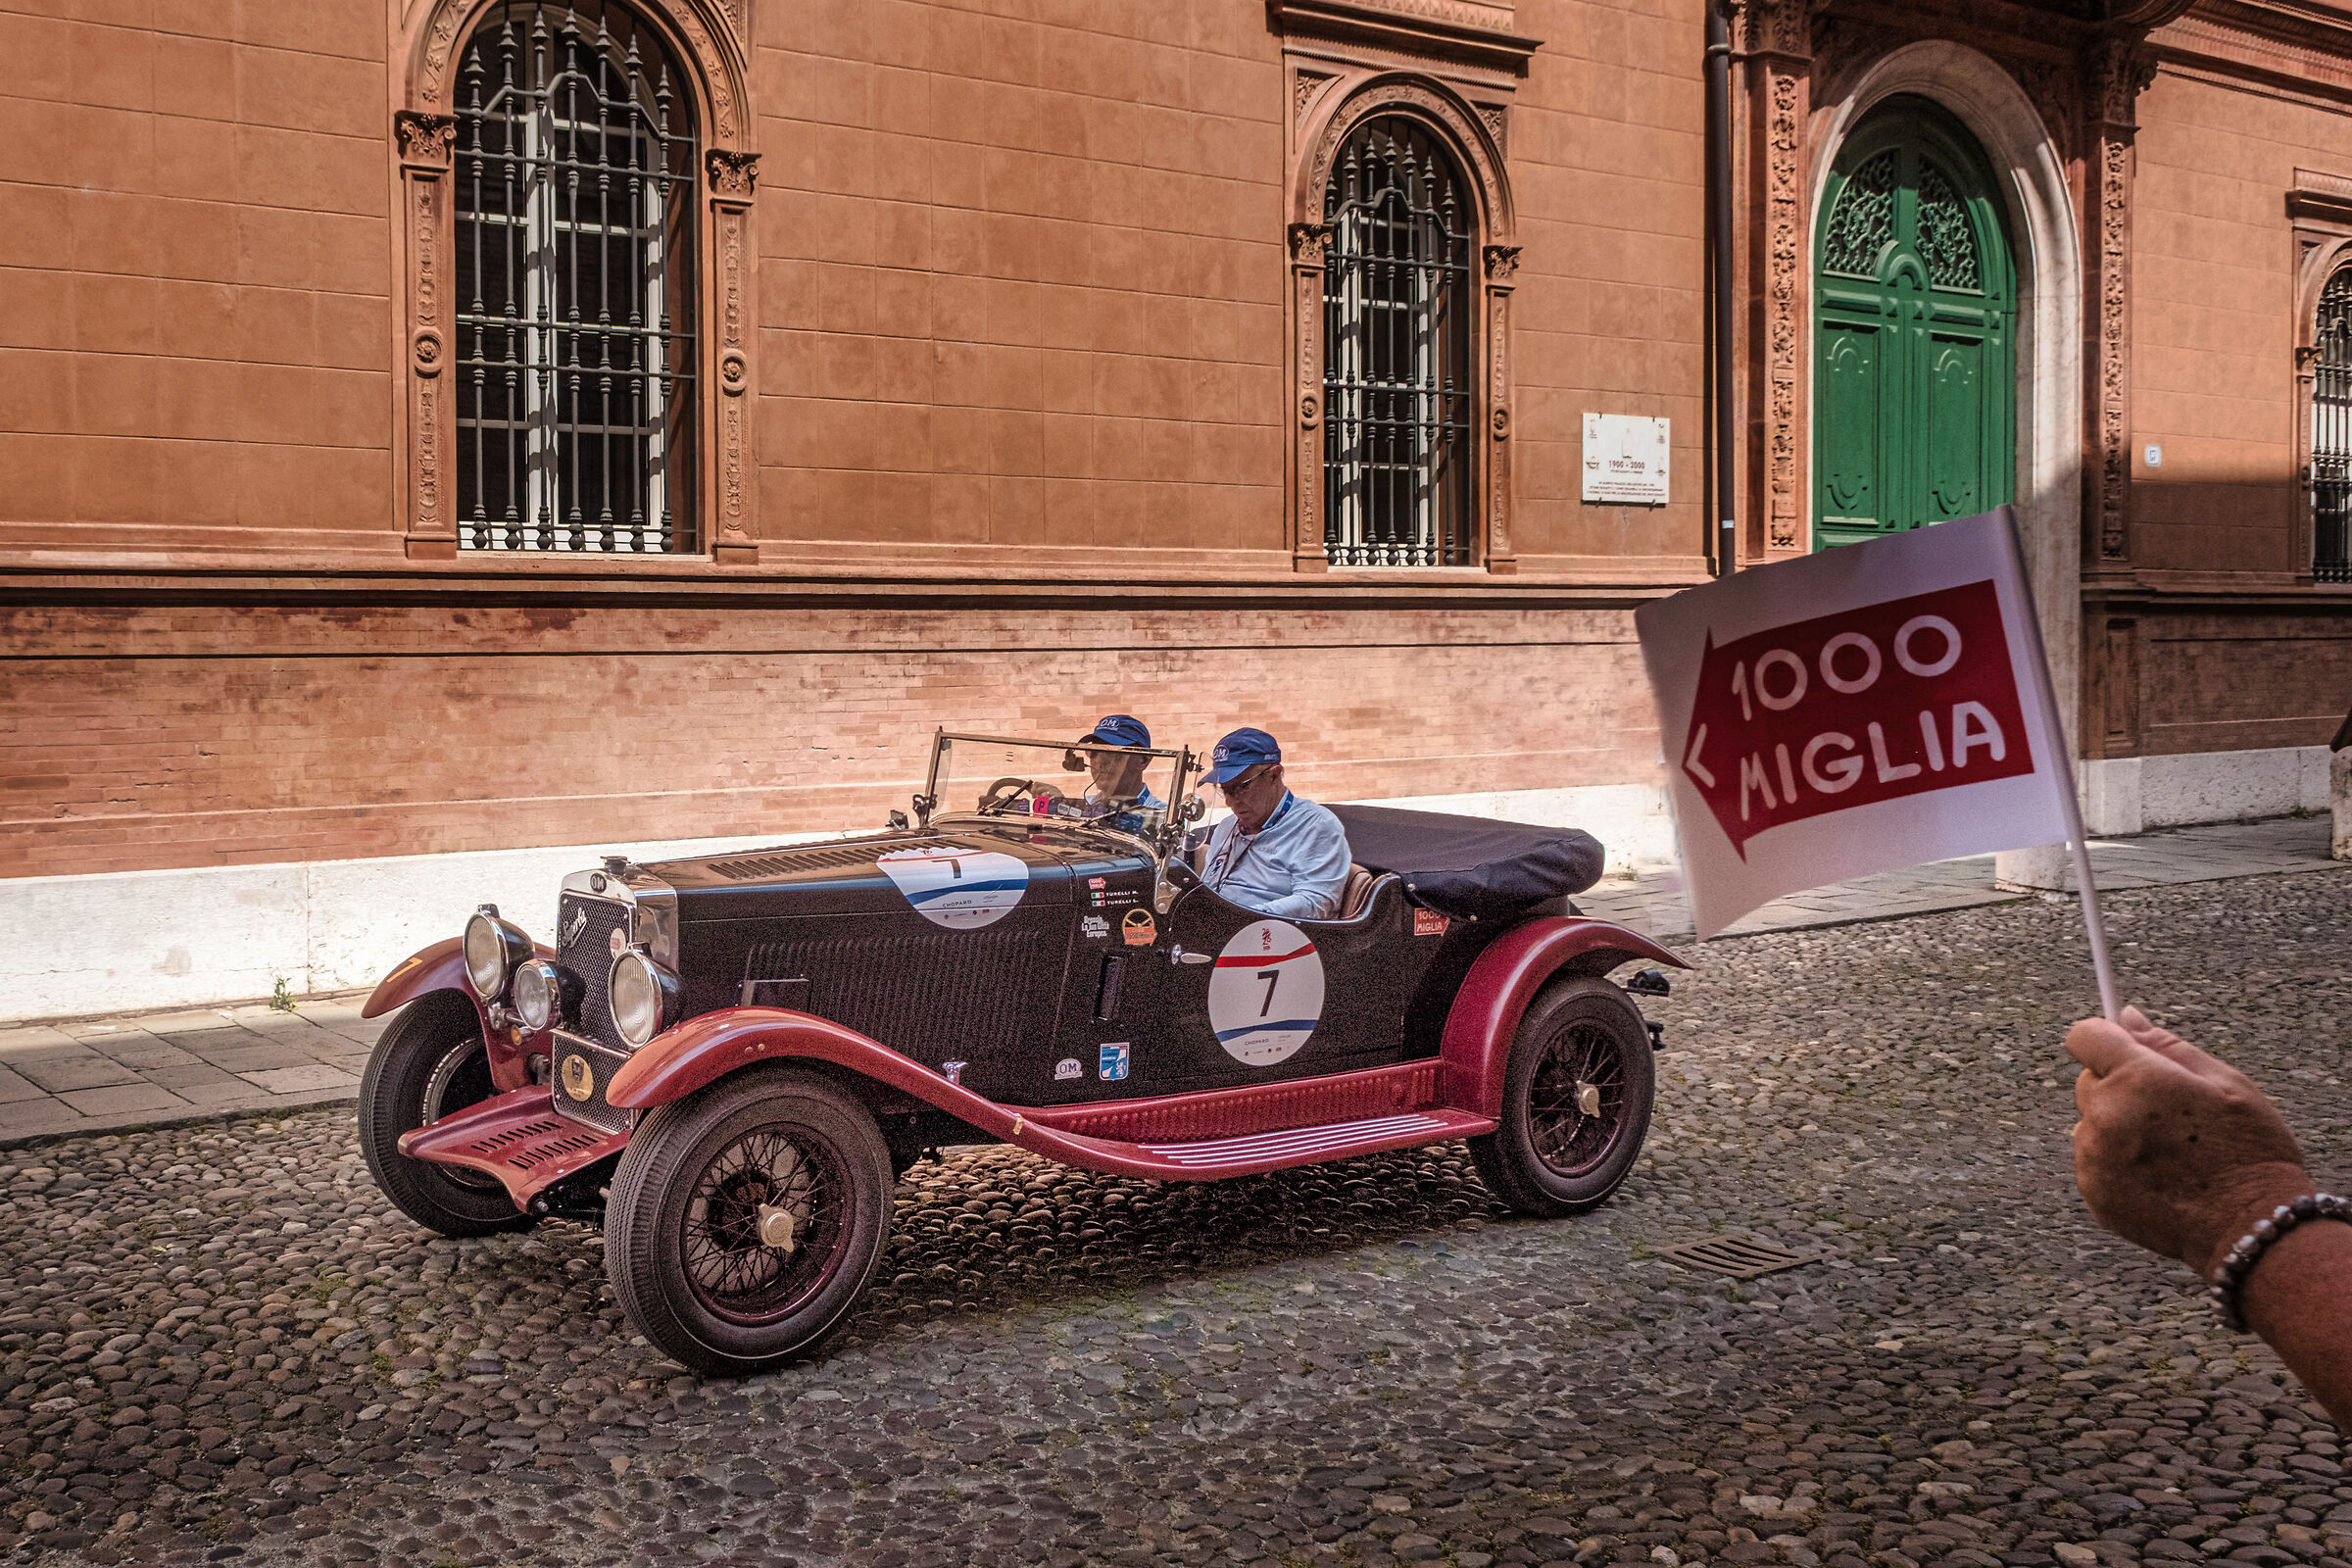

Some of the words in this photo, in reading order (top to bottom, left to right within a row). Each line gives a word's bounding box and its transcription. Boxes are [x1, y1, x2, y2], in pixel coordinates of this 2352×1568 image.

[1630, 461, 1645, 469] 2000
[1732, 614, 1962, 721] 1000
[1740, 701, 2006, 821] MIGLIA
[931, 858, 961, 879] 7
[591, 875, 605, 890] OM
[942, 900, 972, 908] CHOPARD
[1417, 921, 1443, 932] MIGLIA
[386, 956, 423, 983] 7
[1257, 969, 1280, 1017] 7
[1059, 1063, 1077, 1074] OM
